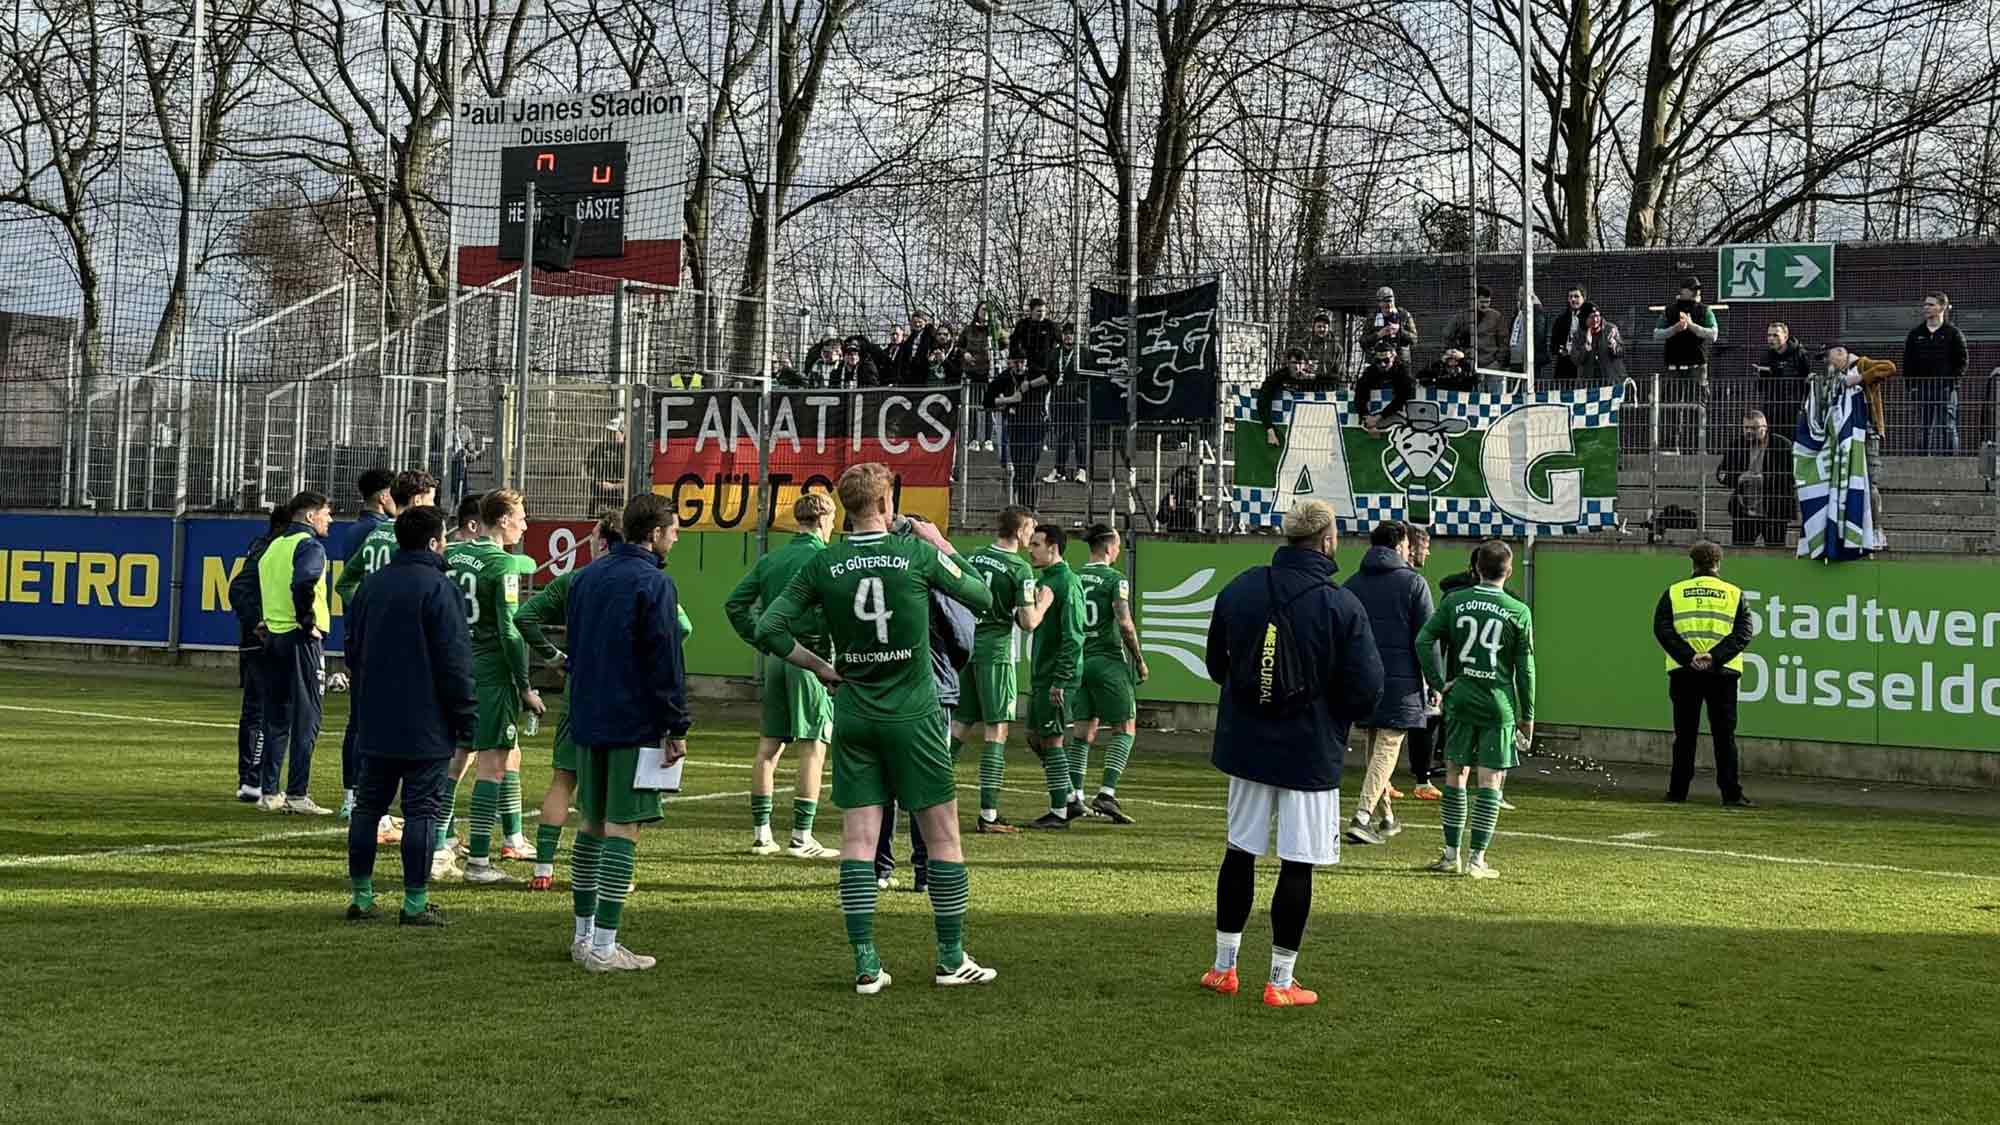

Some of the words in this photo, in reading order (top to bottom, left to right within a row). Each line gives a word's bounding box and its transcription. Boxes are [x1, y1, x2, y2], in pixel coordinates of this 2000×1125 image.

[513, 98, 582, 123] Janes
[591, 91, 683, 121] Stadion
[521, 122, 614, 144] Düsseldorf
[576, 196, 620, 221] GÄSTE
[658, 392, 953, 454] FANATICS
[1270, 401, 1356, 519] A
[1480, 404, 1584, 524] G
[548, 527, 577, 576] 9
[830, 563, 845, 578] FC
[846, 554, 910, 571] GÜTERSLOH
[0, 550, 160, 607] ETRO
[854, 577, 893, 645] 4
[845, 649, 912, 663] BEUCKMANN
[1260, 622, 1277, 704] MERCURIAL
[1456, 615, 1504, 668] 24
